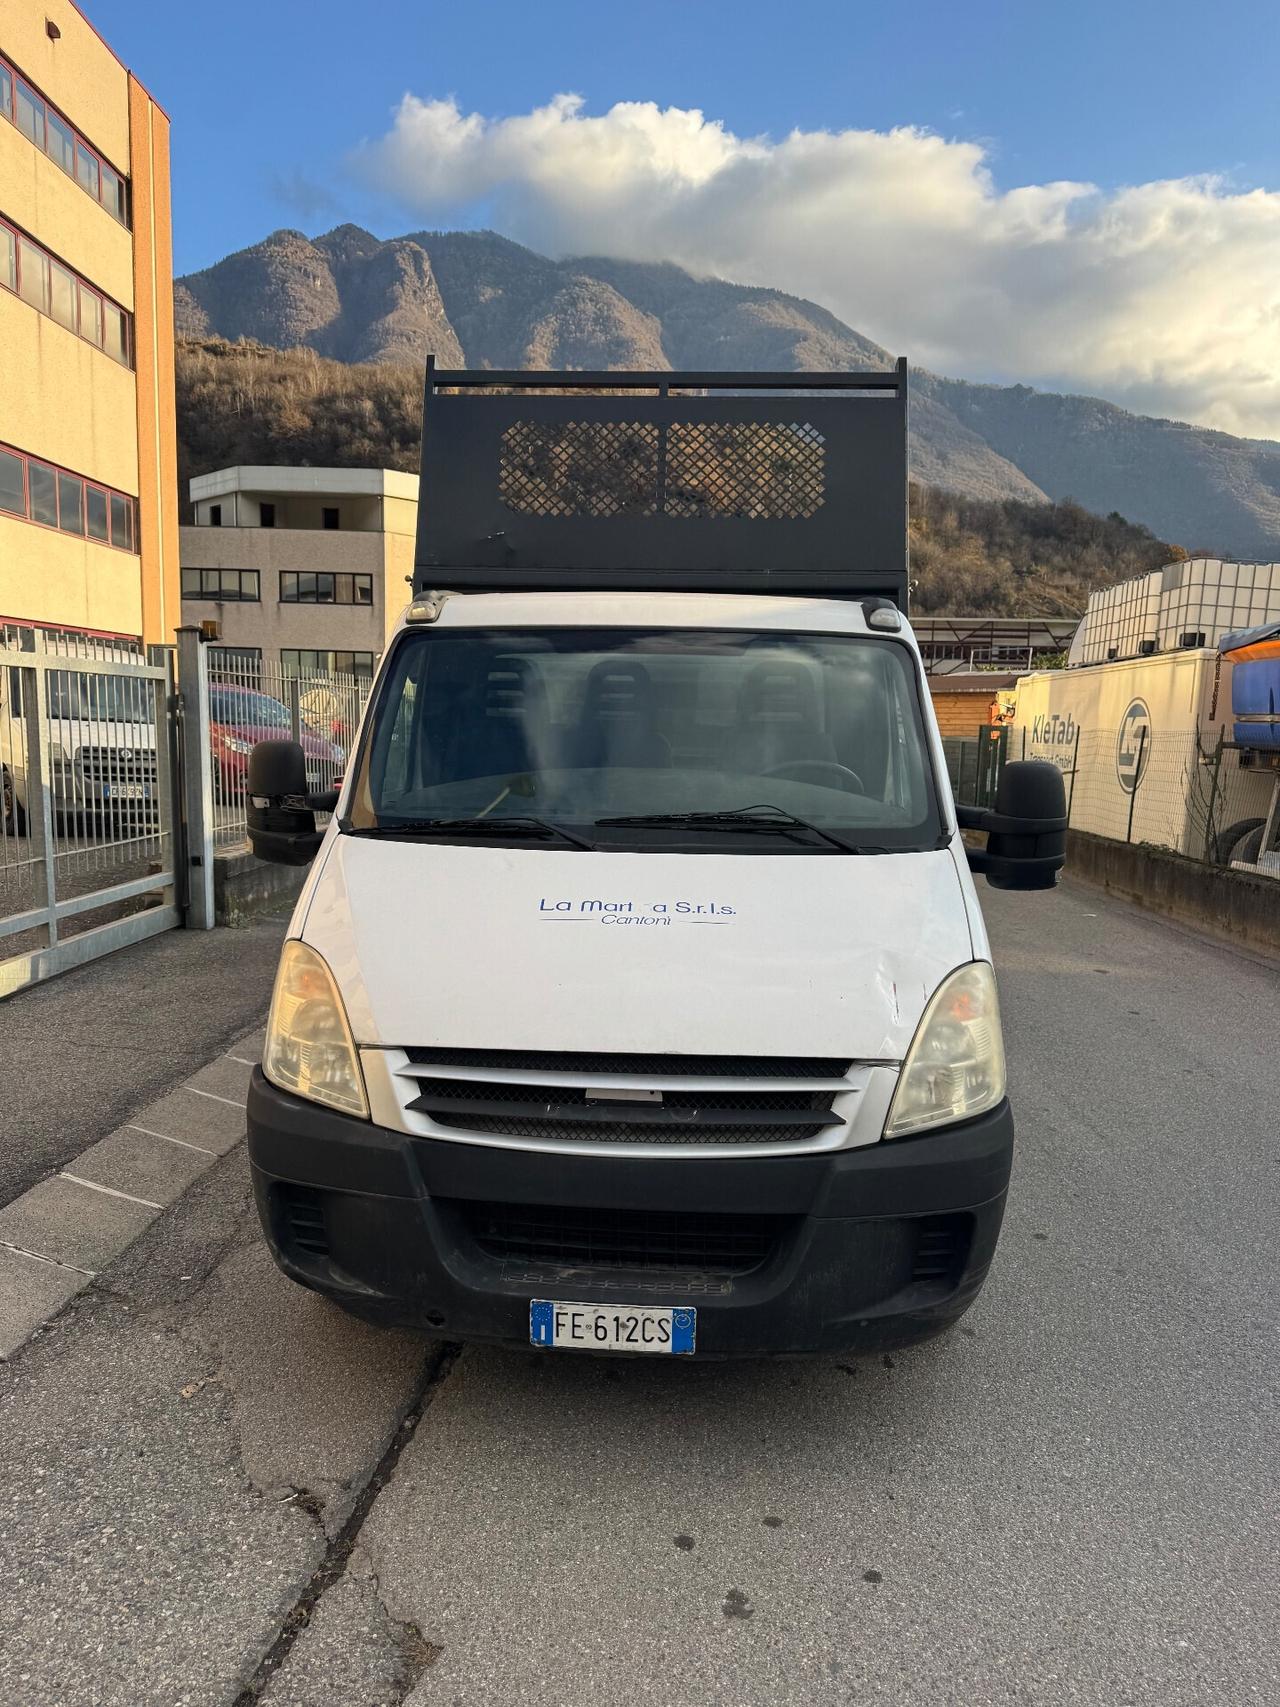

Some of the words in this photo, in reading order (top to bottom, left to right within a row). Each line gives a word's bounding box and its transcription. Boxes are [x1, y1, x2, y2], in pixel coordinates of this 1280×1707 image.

[1032, 713, 1075, 745] KleTab
[539, 898, 572, 912] La
[675, 901, 737, 915] S.r.l.s.
[600, 914, 671, 926] Cantoni
